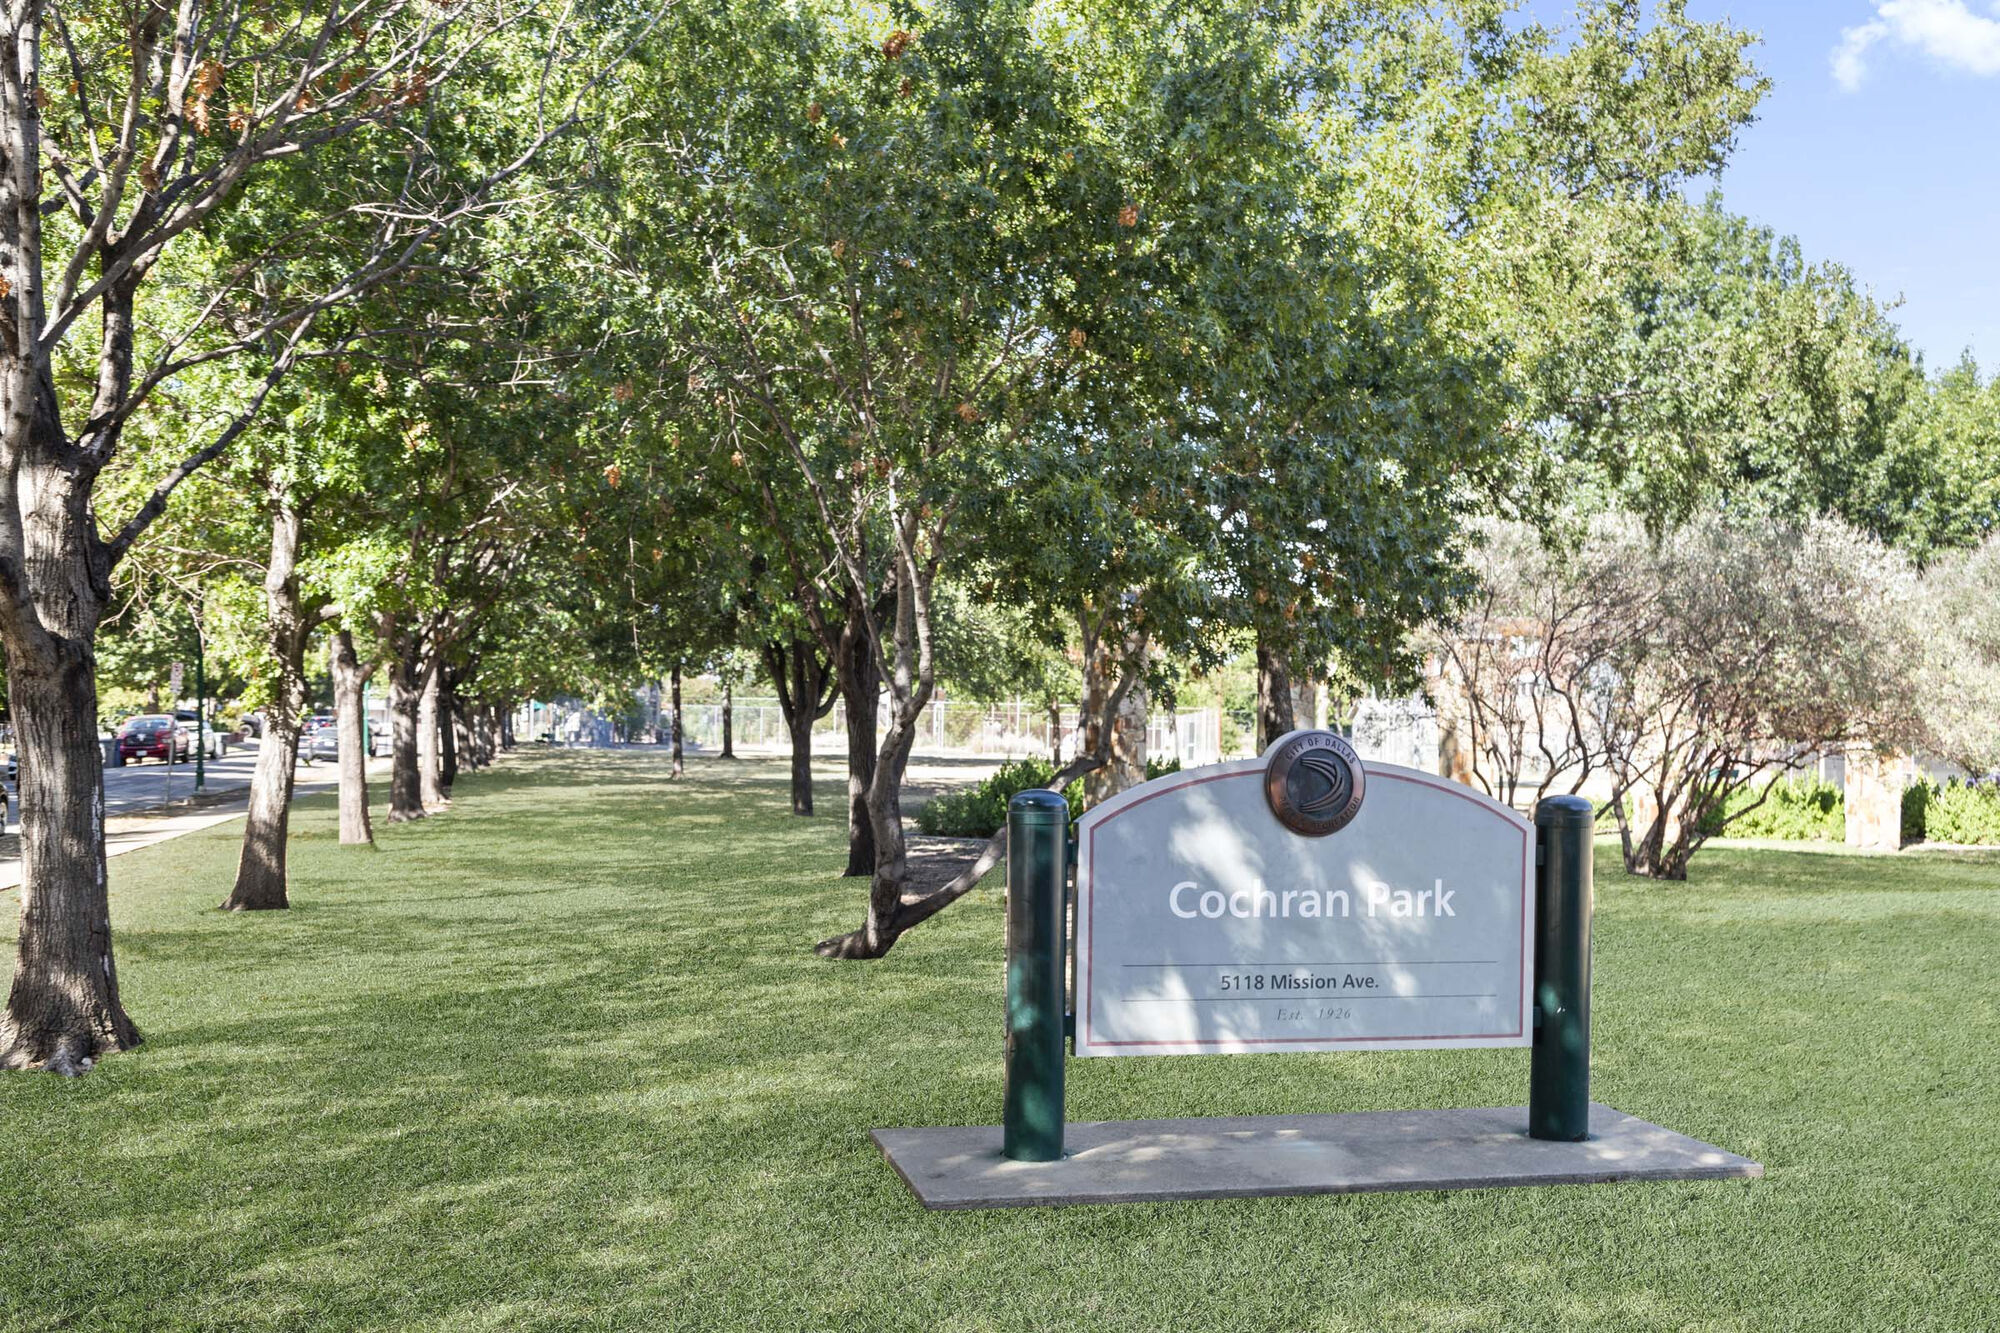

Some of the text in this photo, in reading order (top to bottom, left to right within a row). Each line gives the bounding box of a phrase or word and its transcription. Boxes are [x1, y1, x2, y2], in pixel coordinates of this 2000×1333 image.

[1285, 738, 1357, 765] CITY OF DALLAS
[1168, 878, 1456, 919] Cochran Park
[1220, 973, 1380, 991] 5118 Mission Ave.
[1276, 1007, 1352, 1021] Est. 1926
